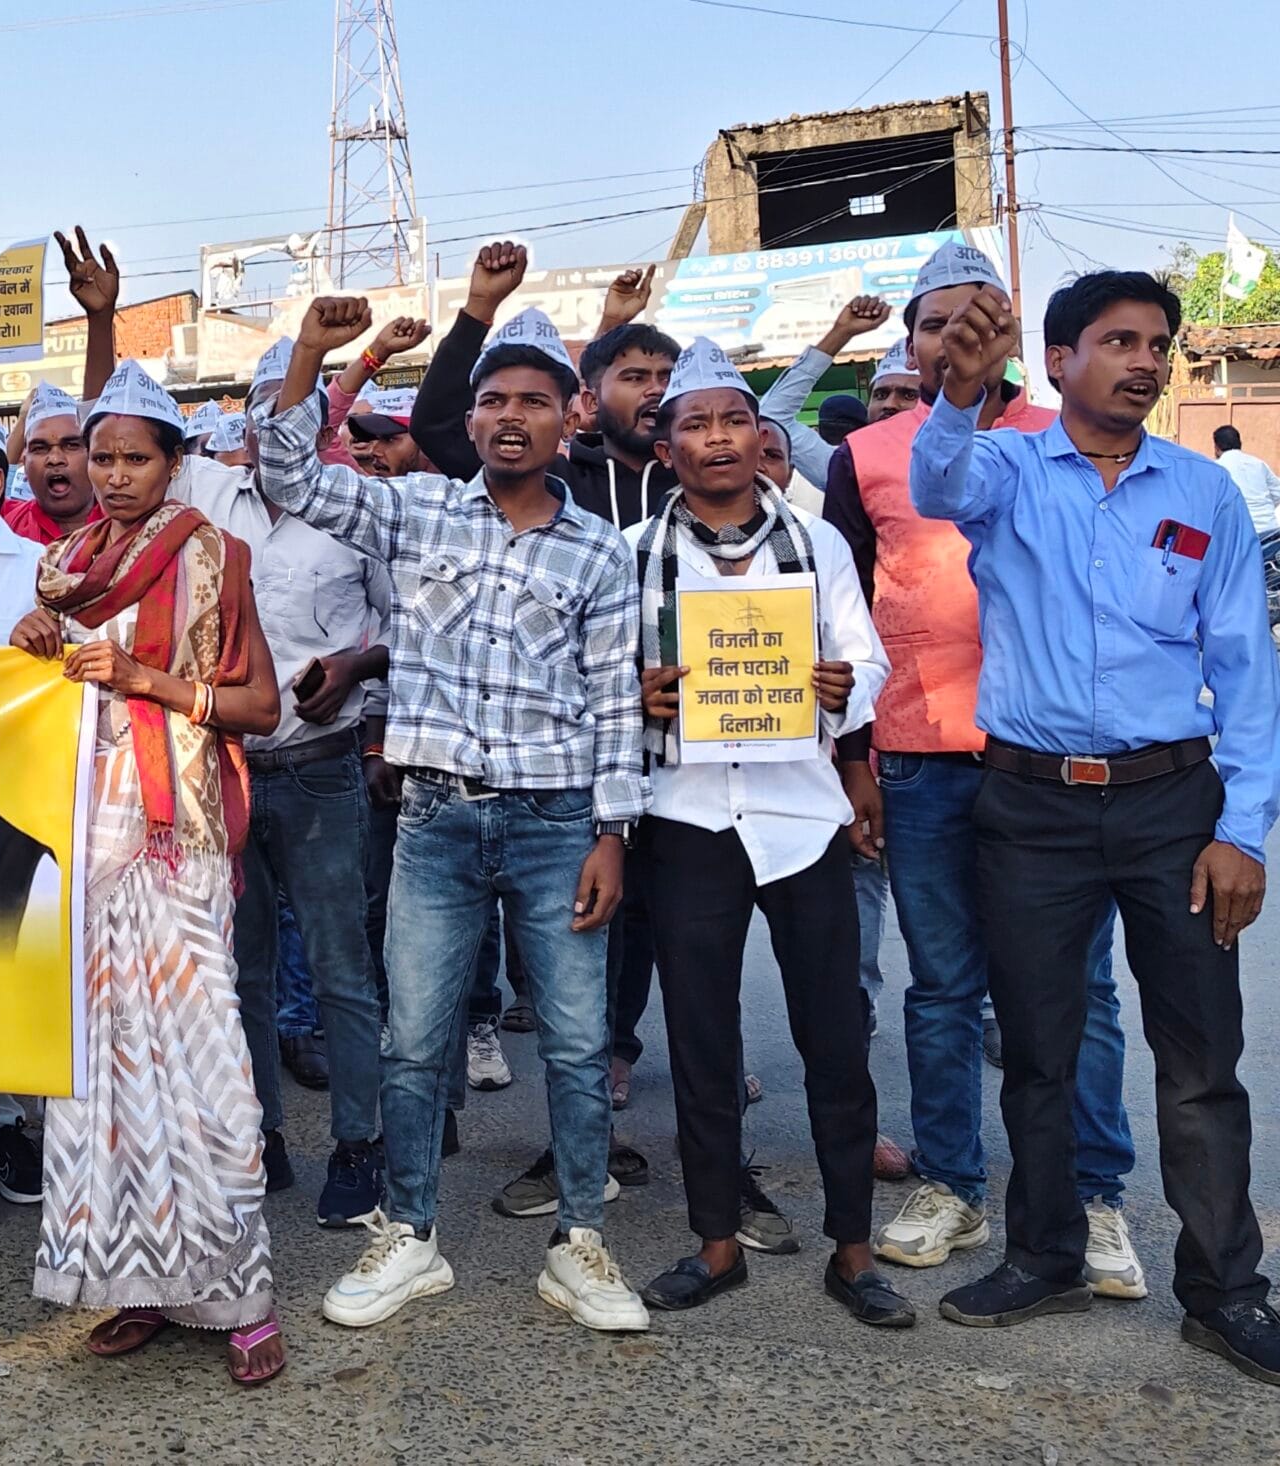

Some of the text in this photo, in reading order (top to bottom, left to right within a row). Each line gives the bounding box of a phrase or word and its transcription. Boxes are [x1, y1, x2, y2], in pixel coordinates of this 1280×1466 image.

[755, 239, 902, 271] 8839136007
[19, 279, 32, 294] में
[3, 303, 34, 316] खाना
[44, 335, 88, 354] PUTE
[708, 627, 784, 649] बिजली का
[707, 656, 790, 677] बिल घटाओ
[695, 684, 805, 705] जनता को राहत
